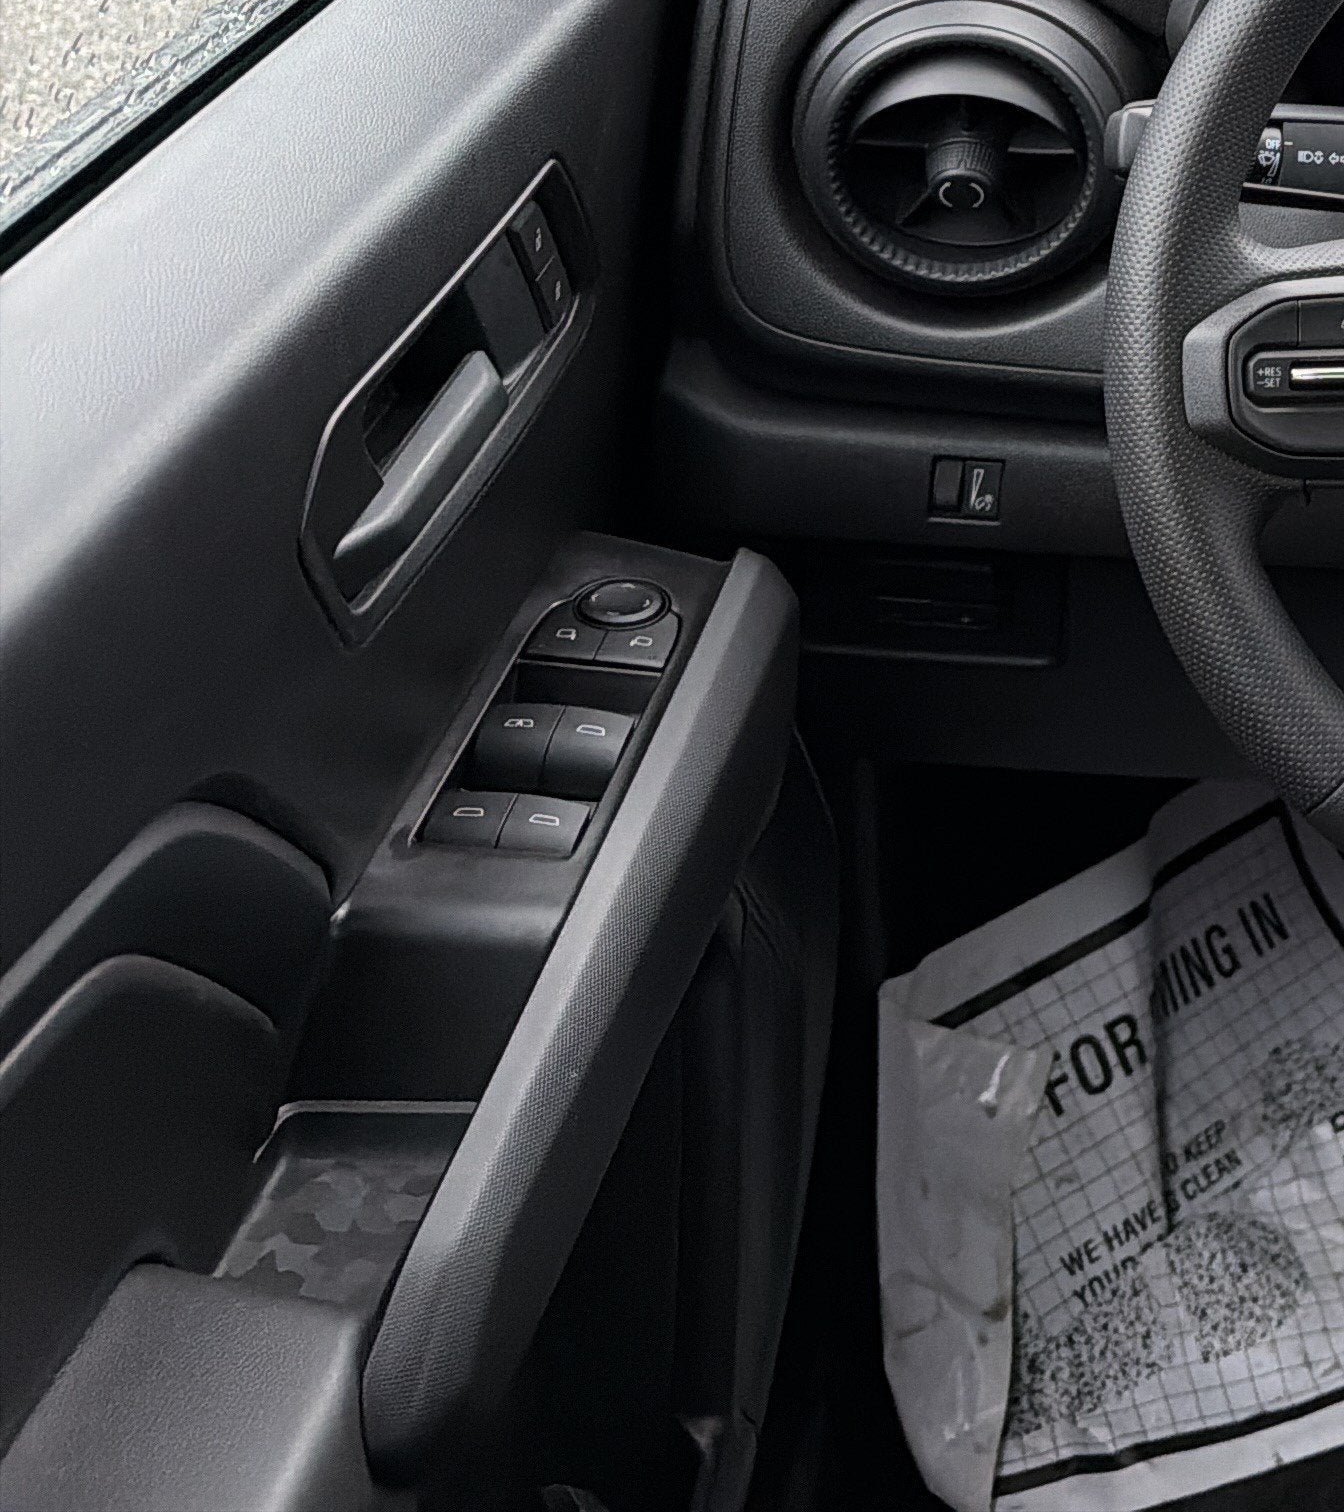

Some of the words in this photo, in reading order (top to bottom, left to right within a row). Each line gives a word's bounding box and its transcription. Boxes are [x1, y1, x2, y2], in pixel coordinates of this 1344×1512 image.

[1238, 892, 1289, 958] IN
[1183, 1118, 1227, 1164] KEEP
[1180, 1147, 1242, 1202] CLEAN
[1059, 1238, 1101, 1277] WE
[1102, 1199, 1163, 1253] HAVE
